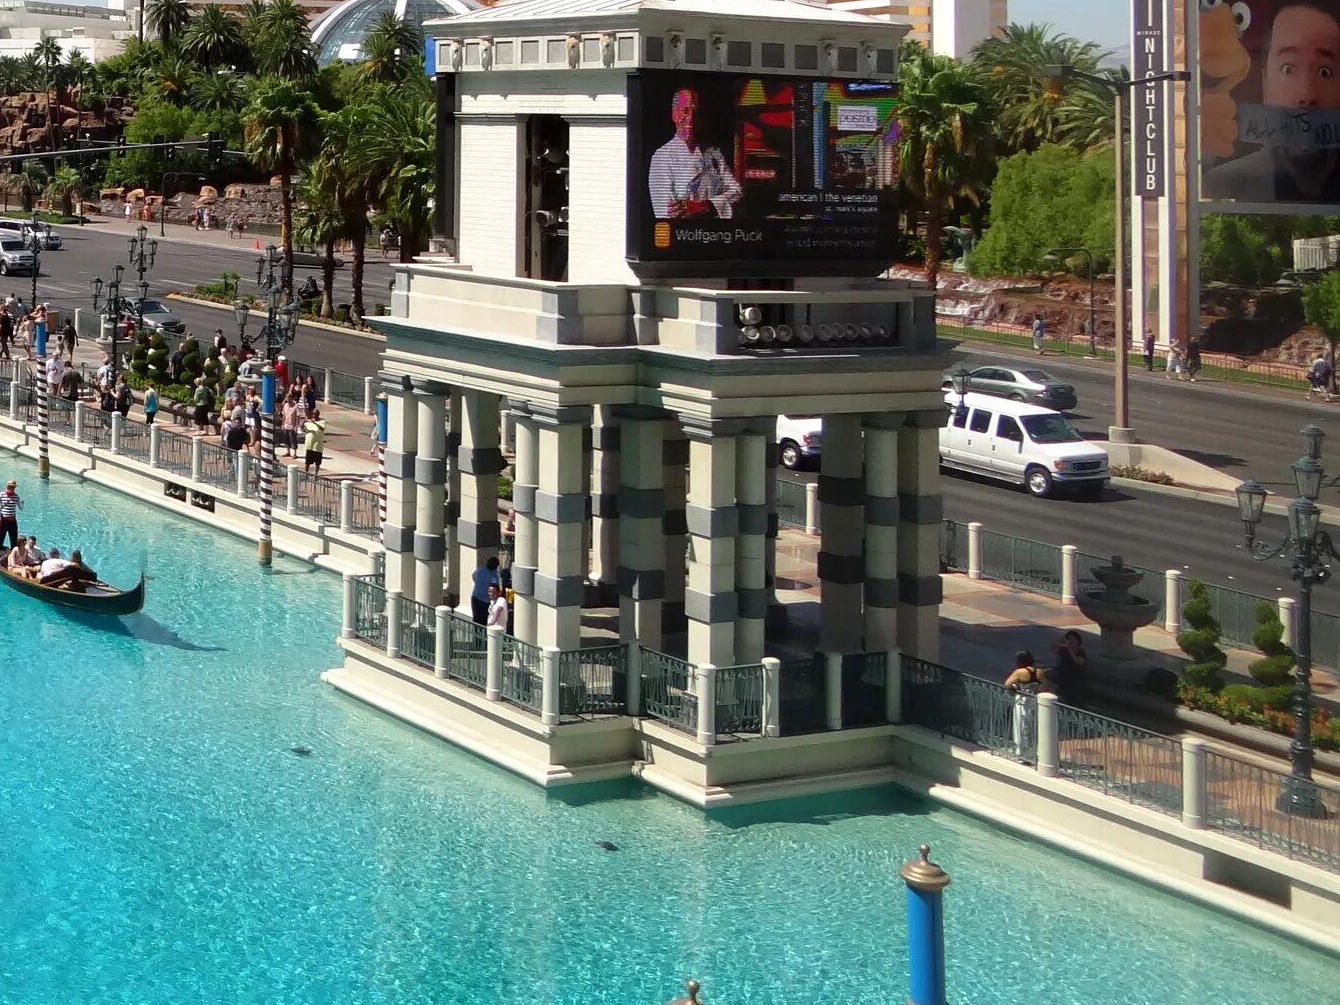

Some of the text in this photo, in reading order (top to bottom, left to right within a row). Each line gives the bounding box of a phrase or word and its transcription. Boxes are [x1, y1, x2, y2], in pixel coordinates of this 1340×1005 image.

[1144, 39, 1156, 191] NIGHTCLUB
[1280, 112, 1312, 139] HITS
[778, 192, 878, 204] american the venetian
[675, 228, 763, 244] Wolfgang Puck
